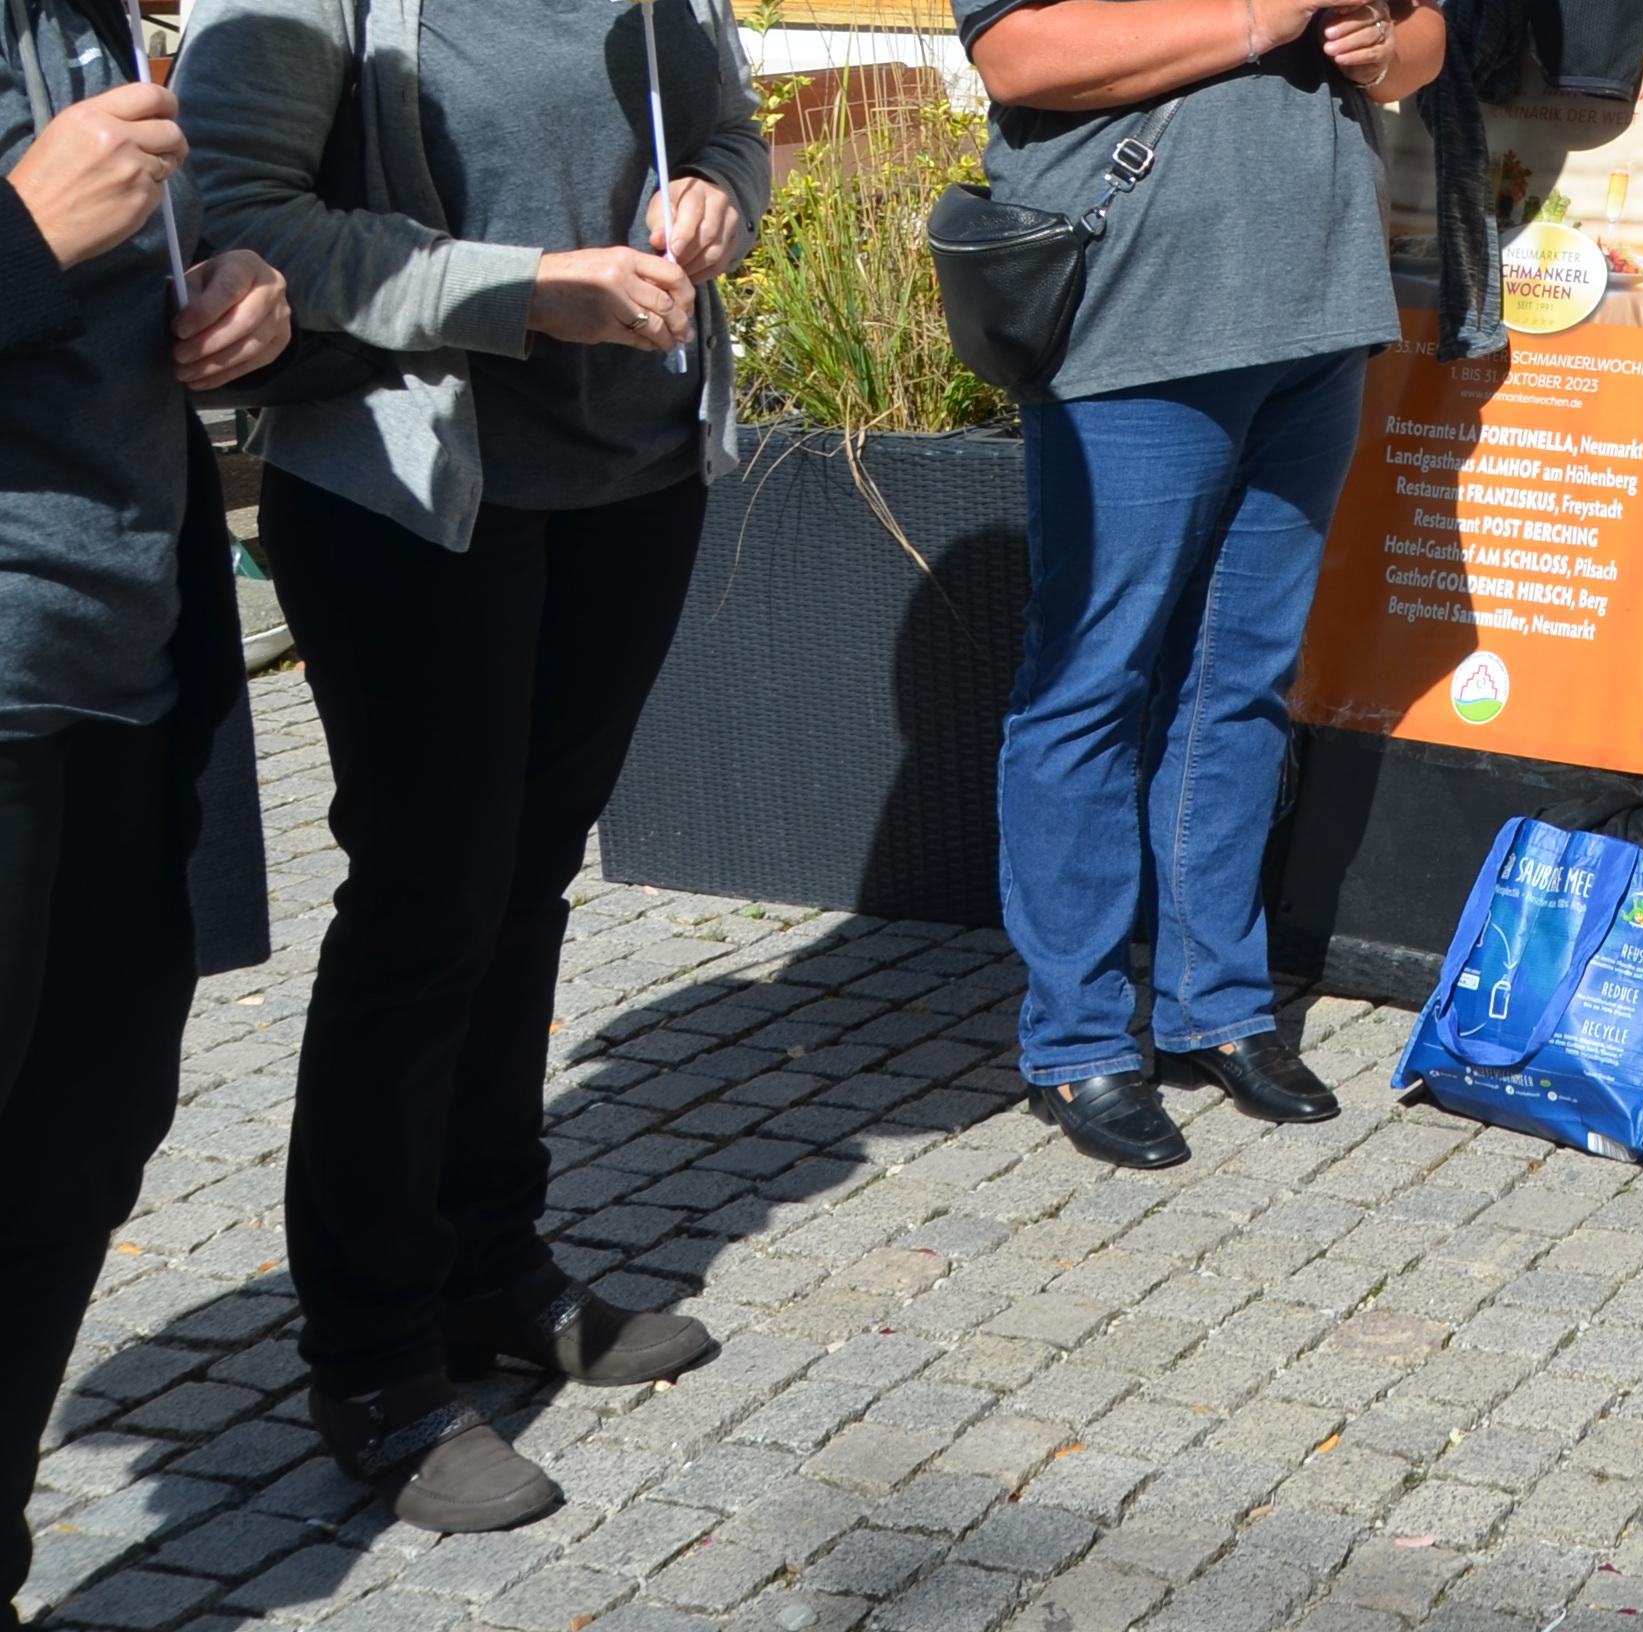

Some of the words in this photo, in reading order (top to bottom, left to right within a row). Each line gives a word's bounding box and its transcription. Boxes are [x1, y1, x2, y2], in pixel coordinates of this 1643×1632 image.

[1567, 107, 1597, 123] DER
[1506, 247, 1581, 265] NEUMARKTER
[1501, 263, 1590, 285] CHMANKERL
[1507, 281, 1572, 300] WOCHEN
[1517, 300, 1533, 311] SEIT
[1461, 367, 1482, 383] BIS
[1503, 373, 1562, 390] OKTOBER
[1564, 376, 1599, 393] 2023
[1385, 416, 1456, 441] Ristorante
[1458, 422, 1477, 443] LA
[1479, 424, 1578, 457] FORTUNELLA,
[1385, 446, 1475, 474] Landgasthaus
[1476, 454, 1541, 478] ALMHOF
[1542, 466, 1562, 481] am
[1565, 464, 1638, 497] Höhenberg
[1396, 476, 1464, 503] Restaurant
[1466, 483, 1559, 516] FRANZISKUS,
[1562, 494, 1623, 522] Freystadt
[1414, 508, 1480, 534] Restaurant
[1482, 515, 1522, 538] POST
[1523, 520, 1599, 548] BERCHING
[1384, 534, 1475, 563] Hotel-Gasthof
[1476, 546, 1501, 568] AM
[1502, 548, 1572, 579] SCHLOSS,
[1574, 558, 1617, 581] Pilsach
[1385, 564, 1436, 588] Gasthof
[1436, 573, 1514, 600] GOLDENER
[1517, 581, 1576, 610] HIRSCH,
[1578, 588, 1608, 617] Berg
[1388, 596, 1449, 623] Berghotel
[1451, 603, 1529, 636] Sammüller,
[1531, 614, 1596, 641] Neumarkt
[1565, 868, 1594, 898] MEE
[1602, 981, 1640, 1004] REDUCE
[1582, 1020, 1629, 1045] RECYCLE
